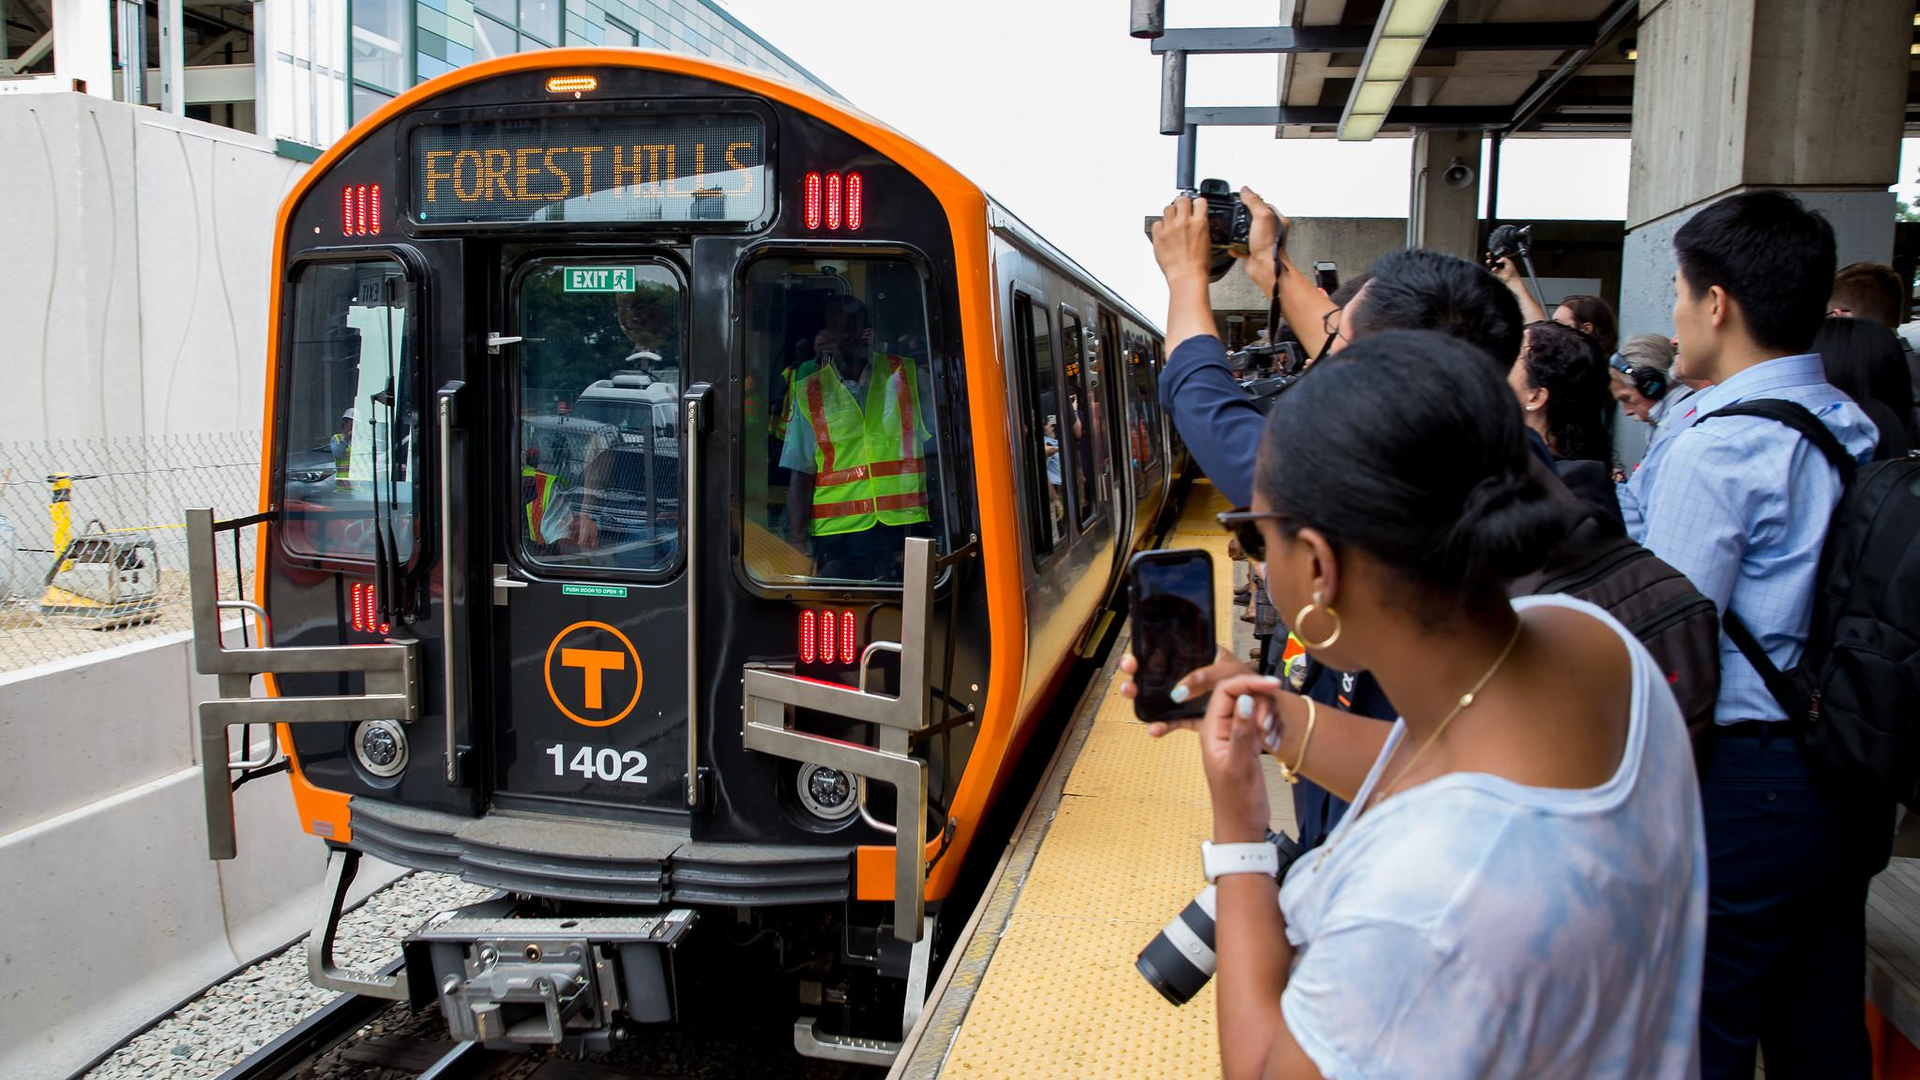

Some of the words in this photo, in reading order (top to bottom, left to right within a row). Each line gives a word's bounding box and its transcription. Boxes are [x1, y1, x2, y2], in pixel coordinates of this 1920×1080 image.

[426, 146, 603, 202] FOREST
[613, 142, 753, 198] HILLS
[573, 270, 608, 288] EXIT
[561, 648, 625, 709] T
[546, 743, 648, 784] 1402
